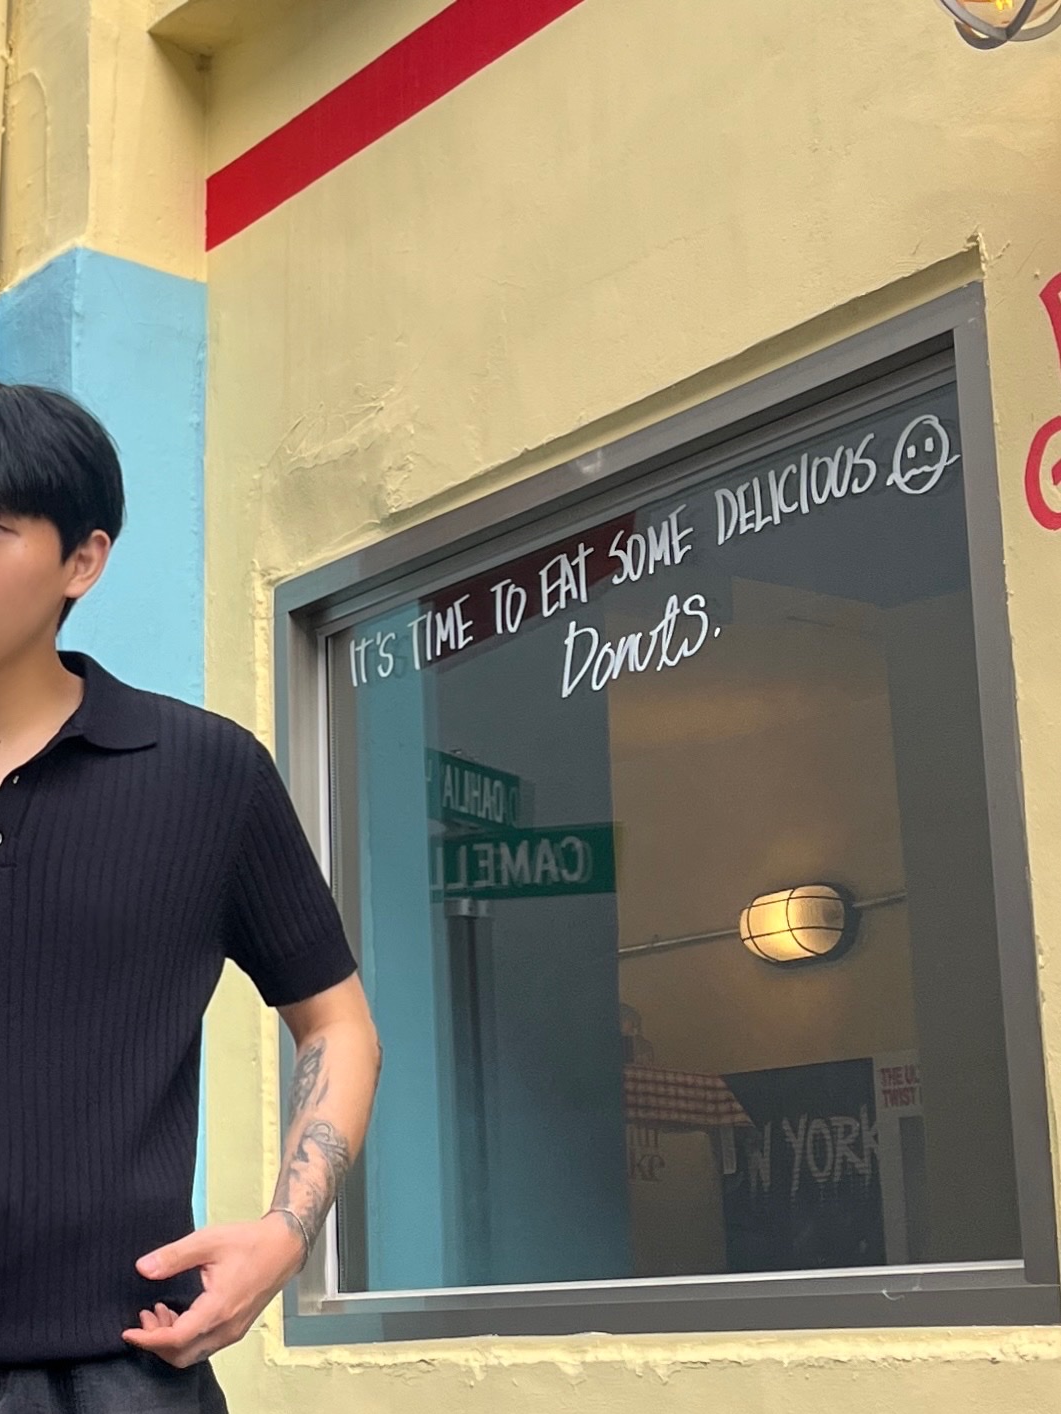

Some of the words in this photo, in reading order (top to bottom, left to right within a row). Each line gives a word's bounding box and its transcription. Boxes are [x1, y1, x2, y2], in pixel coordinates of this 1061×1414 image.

[349, 630, 397, 687] IT'S
[408, 593, 475, 671] TIME
[490, 578, 527, 635] TO
[539, 542, 595, 617] EAT
[608, 504, 694, 584] SOME
[716, 433, 877, 546] DELICIOUS
